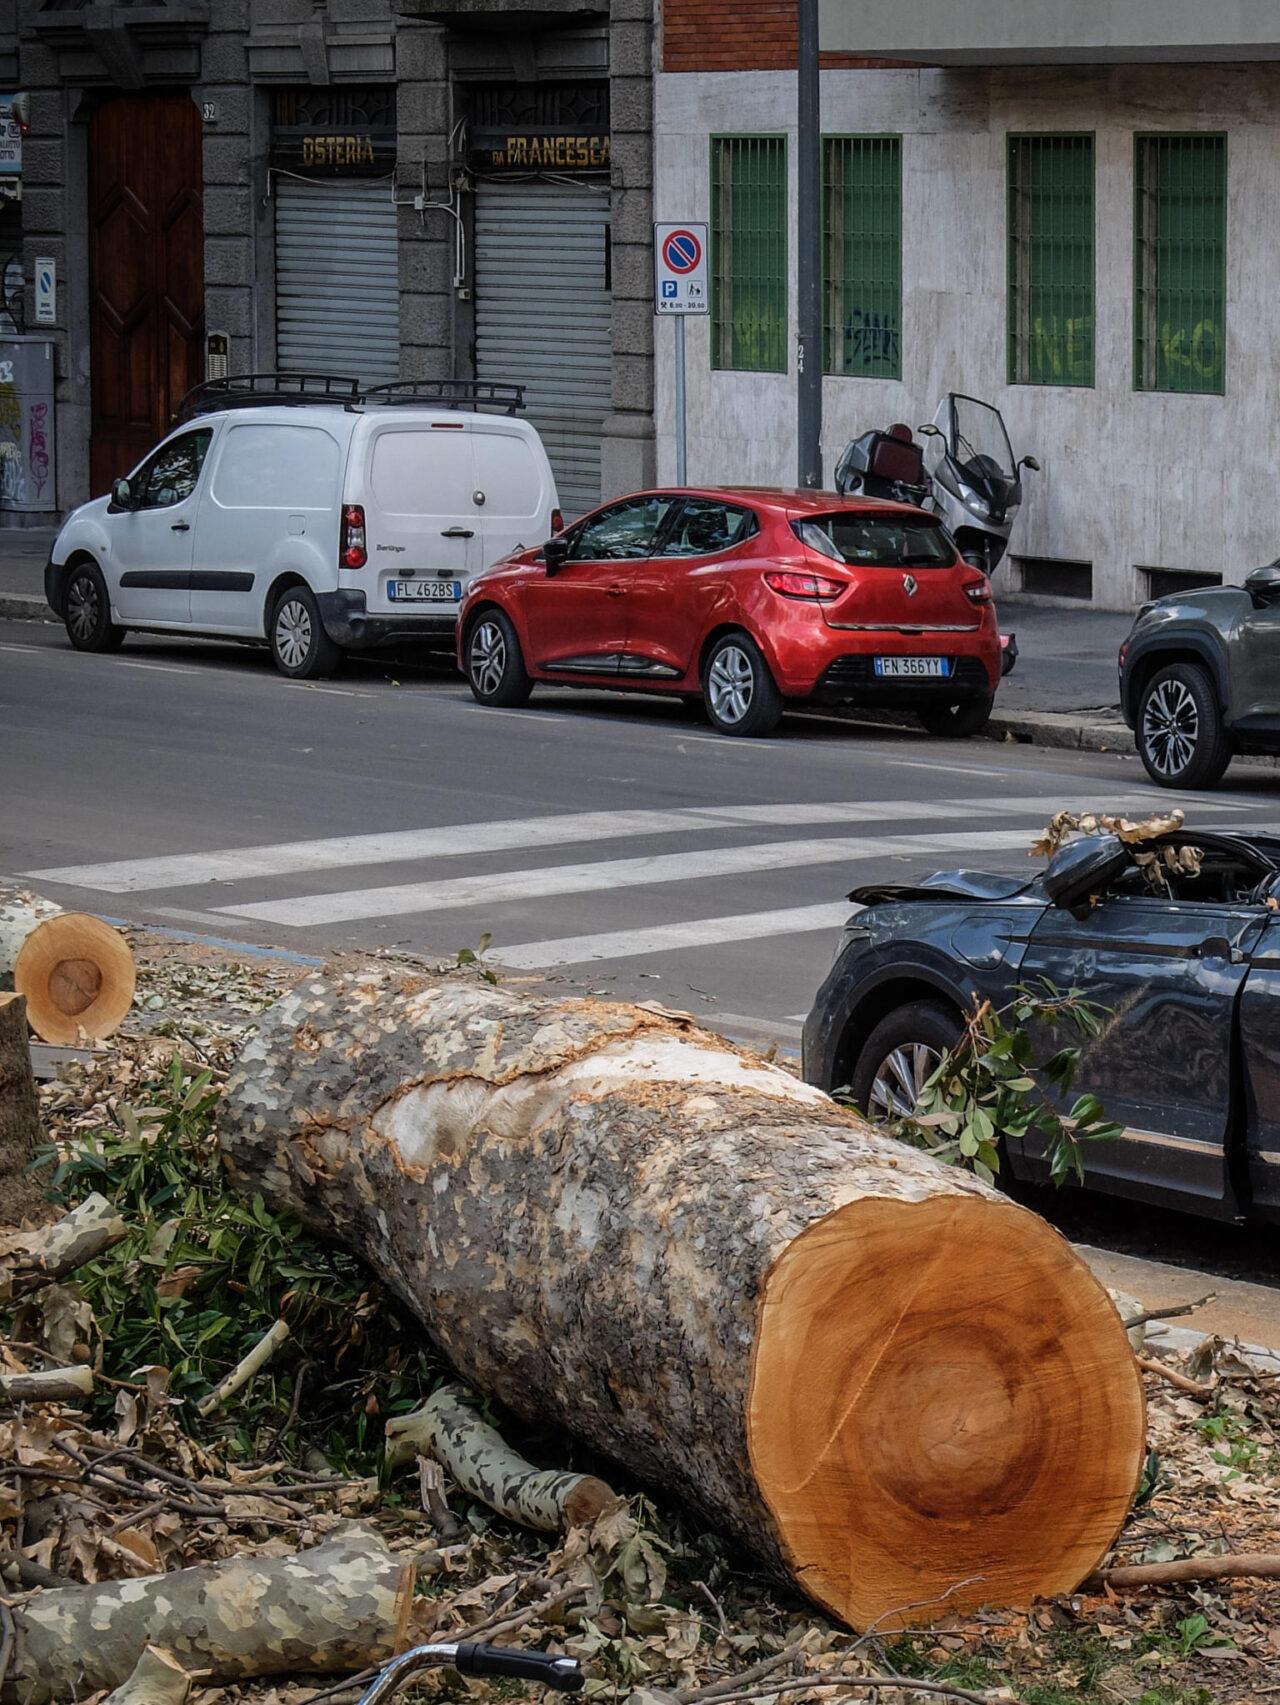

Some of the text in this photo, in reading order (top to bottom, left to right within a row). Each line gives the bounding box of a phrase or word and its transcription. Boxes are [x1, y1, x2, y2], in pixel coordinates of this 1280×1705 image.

[203, 103, 215, 119] 32
[303, 136, 374, 166] OSTERIA
[507, 137, 610, 166] FRANCESCA
[396, 583, 453, 597] FL 462BS
[883, 659, 939, 673] FN 366YY
